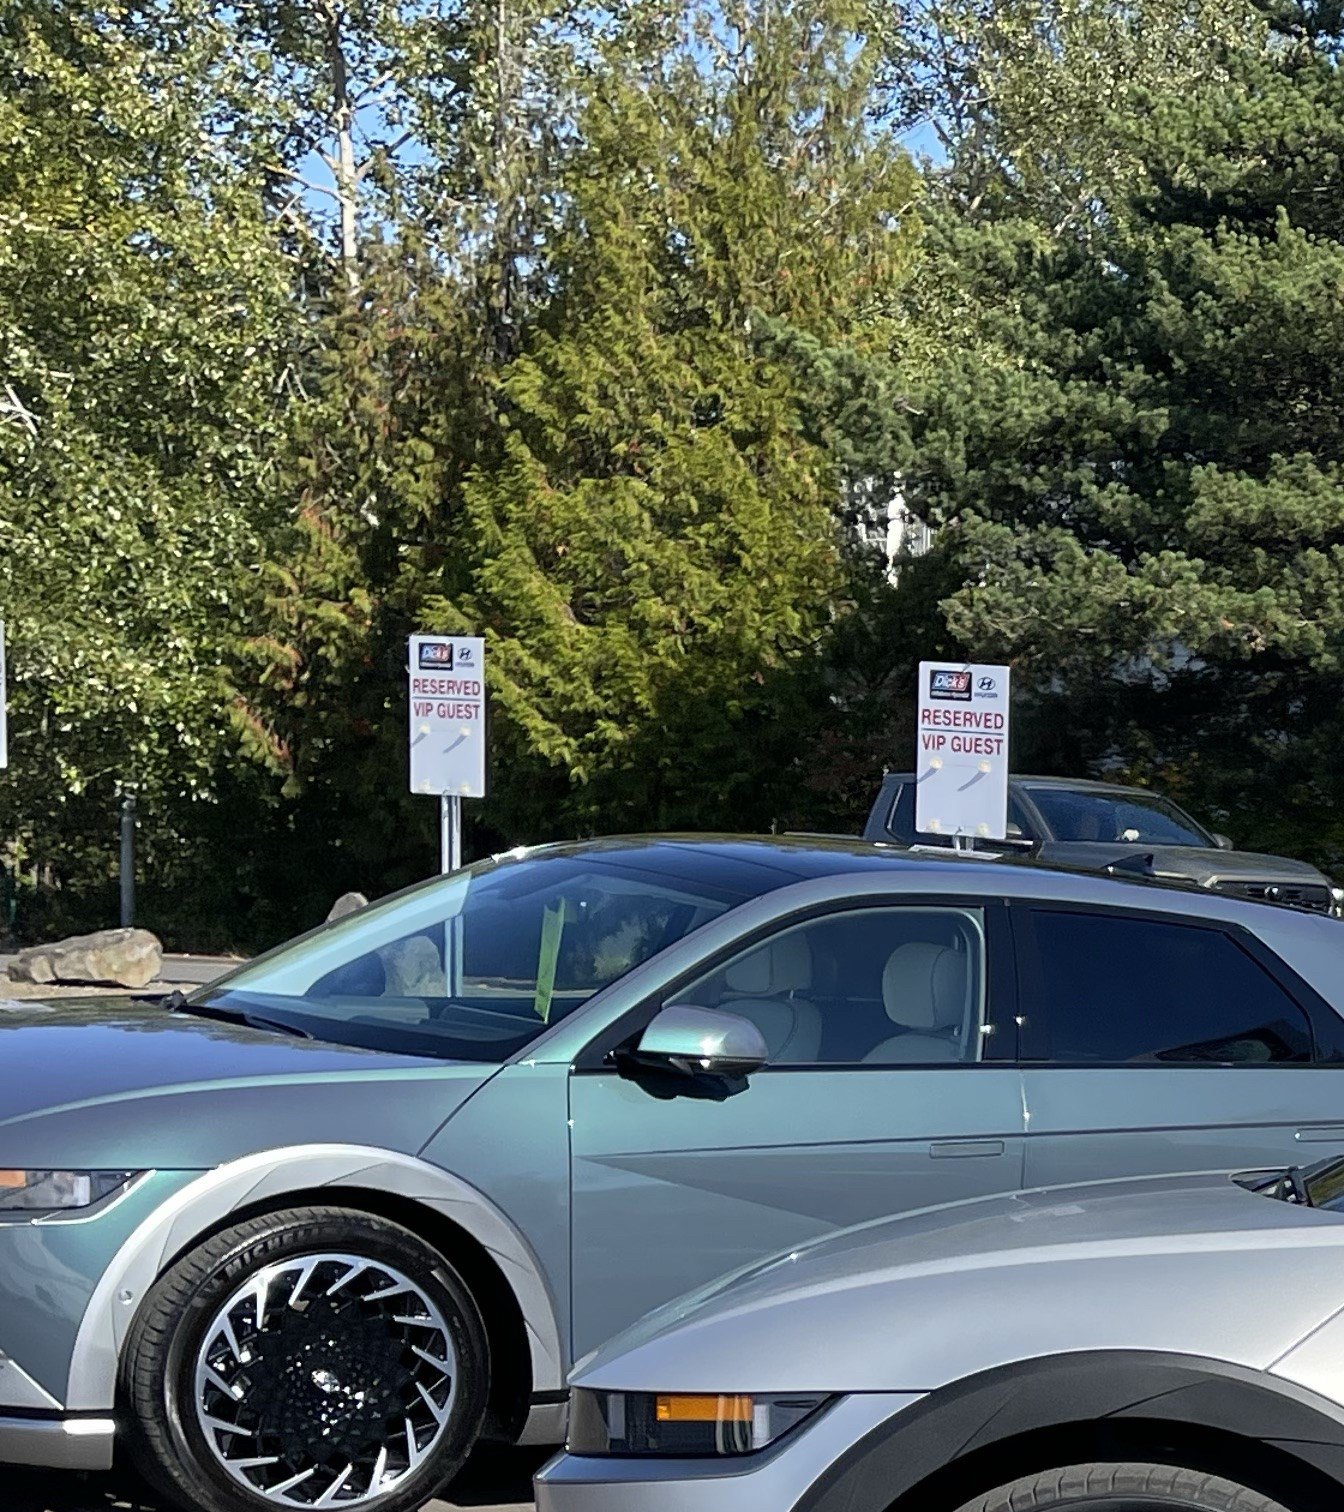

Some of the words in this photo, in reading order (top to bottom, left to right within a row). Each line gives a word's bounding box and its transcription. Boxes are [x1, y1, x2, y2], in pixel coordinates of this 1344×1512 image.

[412, 678, 481, 697] RESERVED
[413, 702, 433, 718] VIP
[436, 703, 481, 720] GUEST
[921, 708, 1004, 730] RESERVED
[922, 734, 946, 751] VIP
[951, 736, 1003, 756] GUEST
